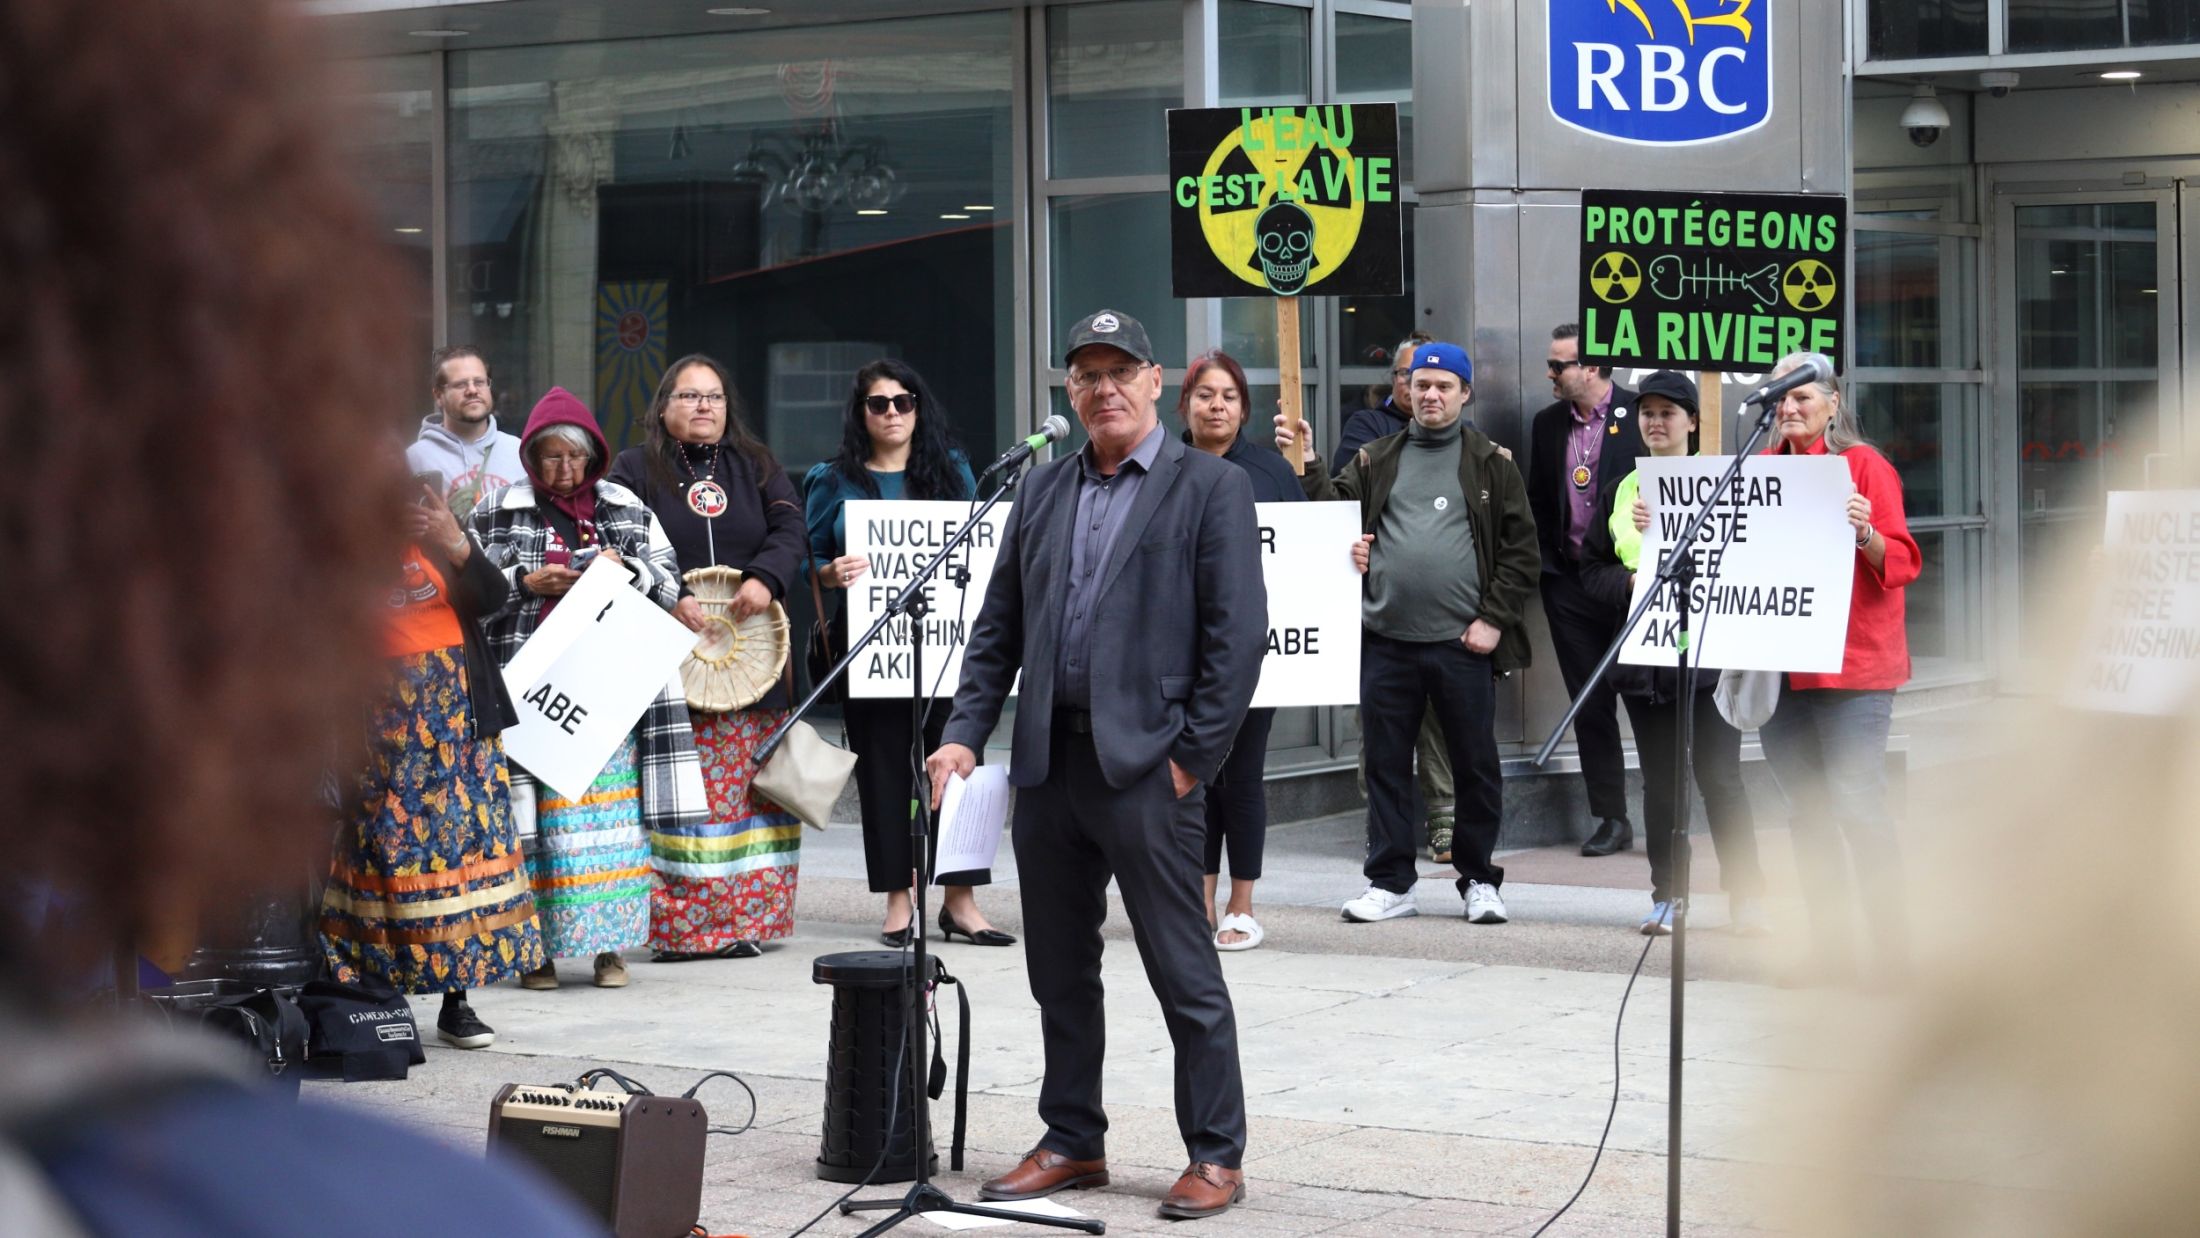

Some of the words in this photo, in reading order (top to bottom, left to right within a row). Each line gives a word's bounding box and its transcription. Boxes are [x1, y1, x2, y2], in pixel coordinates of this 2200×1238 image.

[1572, 41, 1748, 115] RBC
[1241, 103, 1354, 151] L'EAU
[1176, 172, 1265, 208] C'EST
[1586, 200, 1837, 252] PROTÉGEONS
[1585, 308, 1642, 357] LA
[1657, 303, 1837, 367] RIVIÈRE
[1658, 476, 1782, 507] NUCLEAR
[868, 519, 994, 548] NUCLEAR
[1660, 512, 1748, 543] WASTE
[1656, 548, 1721, 579] FEE
[869, 585, 936, 613] FRE
[1648, 584, 1815, 617] ANSHINAABE
[1641, 618, 1680, 648] AK
[867, 652, 910, 679] AKI
[542, 1125, 580, 1137] FISHMAN
